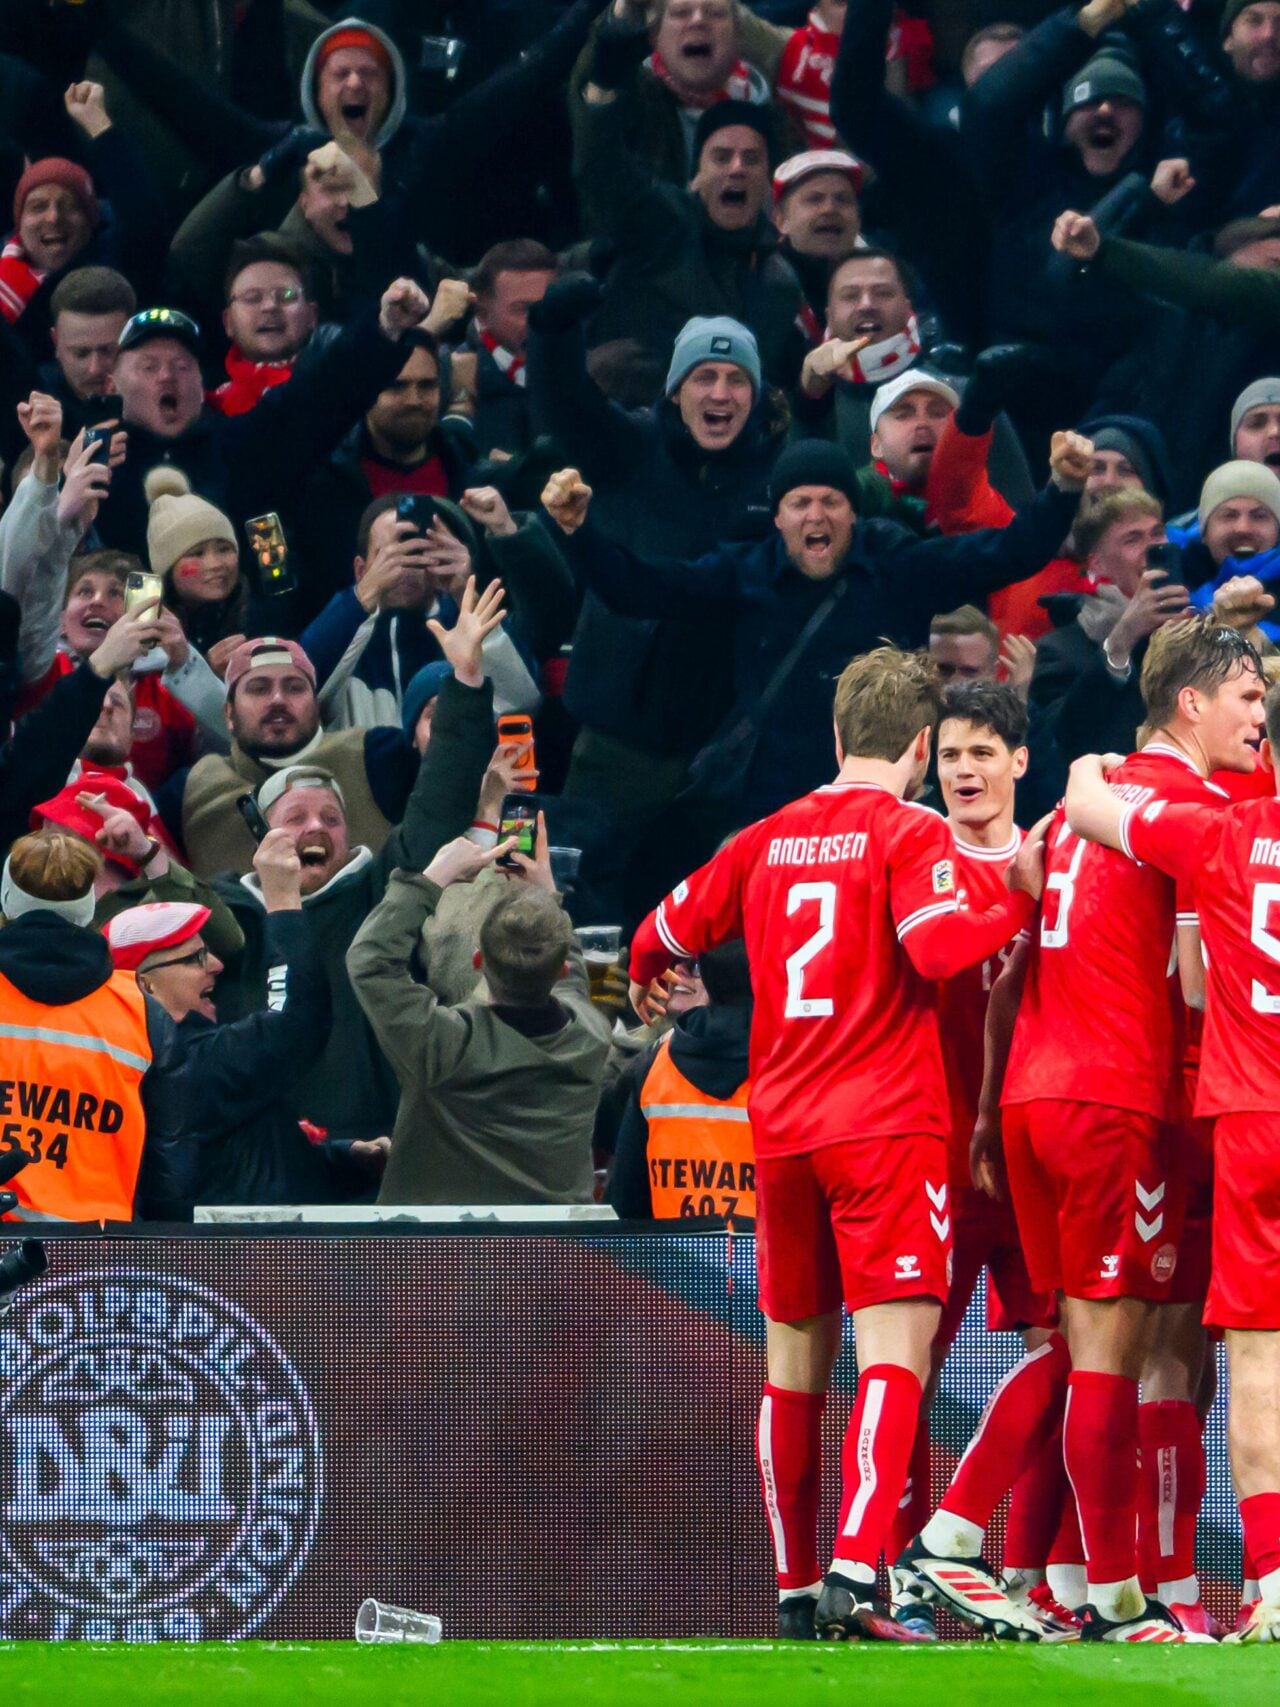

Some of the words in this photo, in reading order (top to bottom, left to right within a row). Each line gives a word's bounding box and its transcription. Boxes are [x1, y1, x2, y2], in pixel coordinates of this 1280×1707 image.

[767, 832, 868, 866] ANDERSEN
[784, 881, 837, 1019] 2
[4, 1405, 236, 1527] DBU
